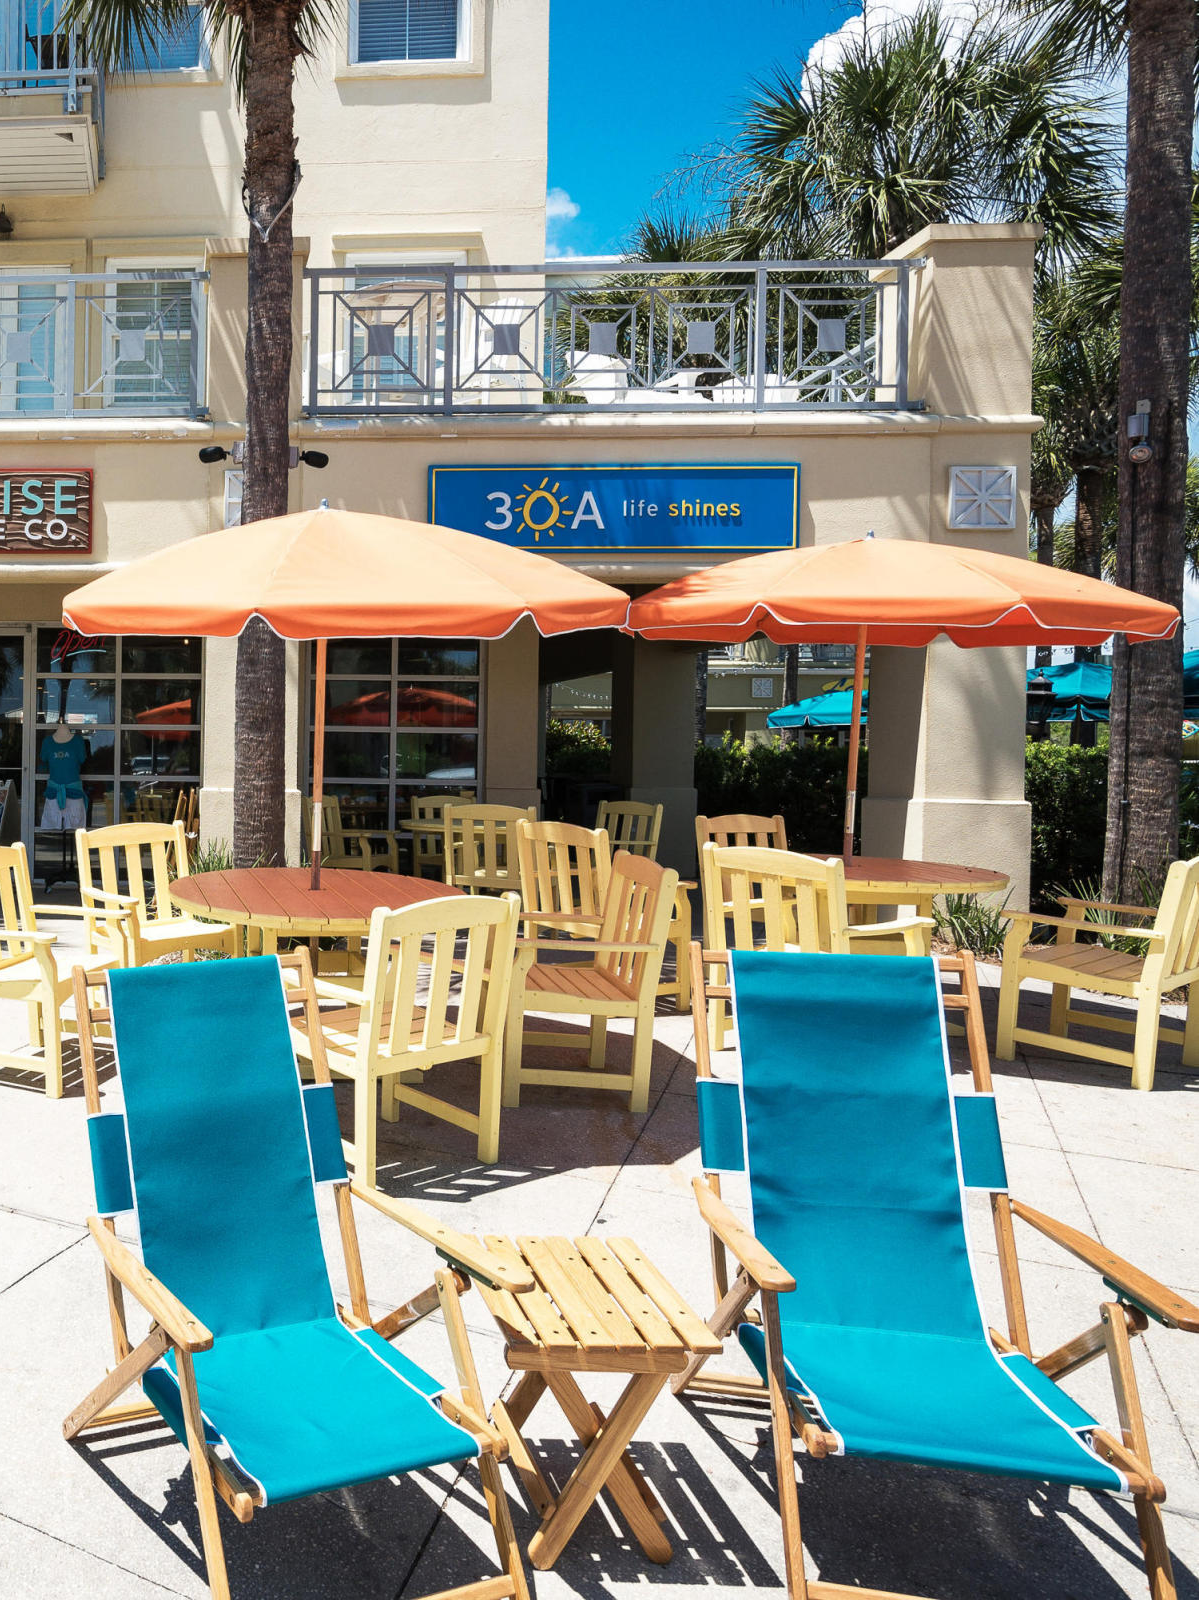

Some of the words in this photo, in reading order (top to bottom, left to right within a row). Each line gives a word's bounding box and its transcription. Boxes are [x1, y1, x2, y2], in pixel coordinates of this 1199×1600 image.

[622, 500, 659, 518] life
[668, 499, 741, 518] shines
[24, 518, 77, 541] CO.
